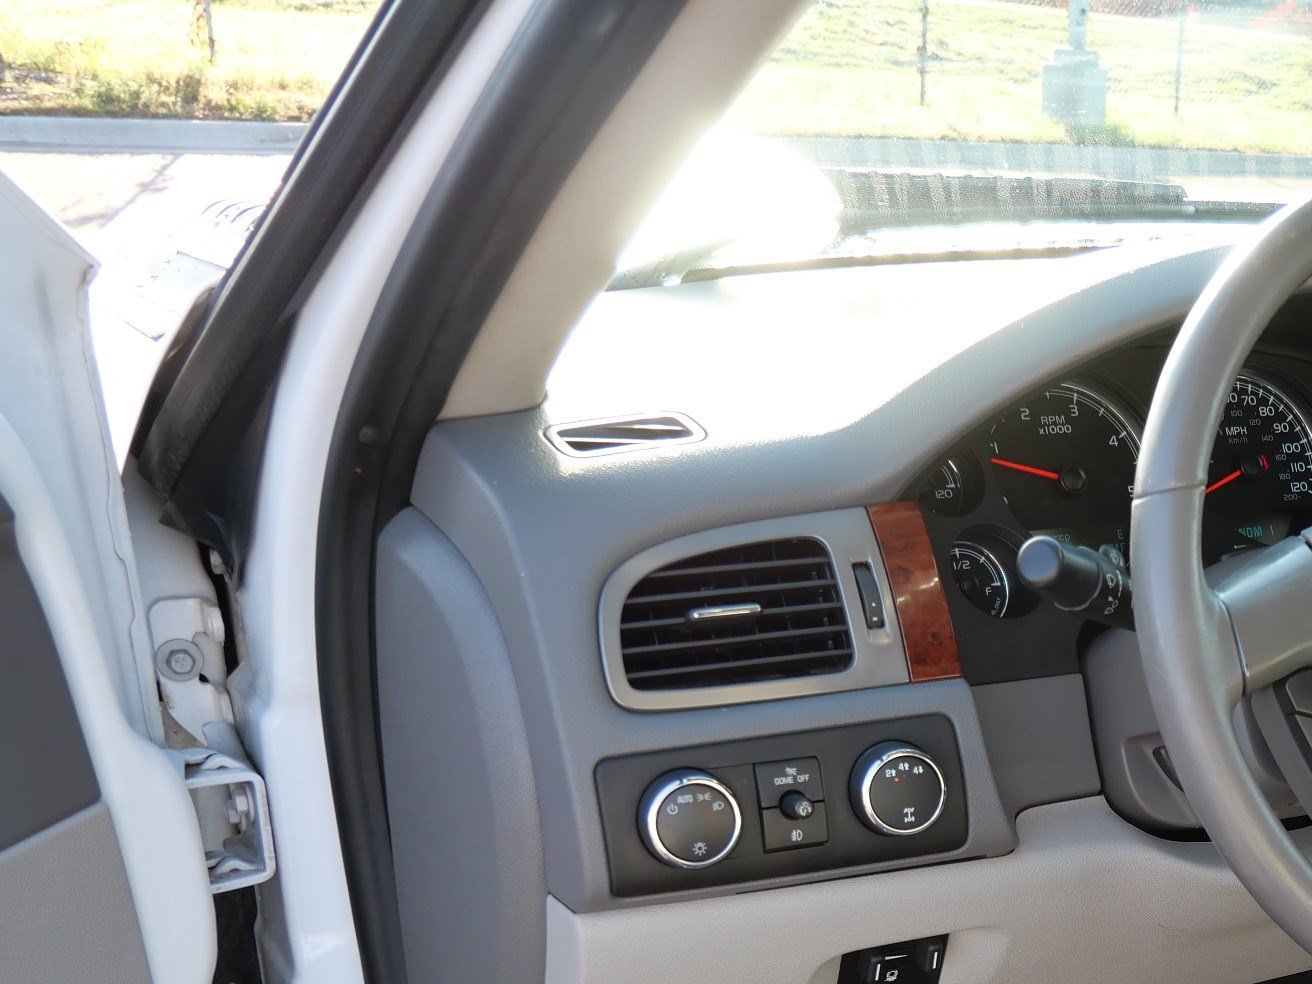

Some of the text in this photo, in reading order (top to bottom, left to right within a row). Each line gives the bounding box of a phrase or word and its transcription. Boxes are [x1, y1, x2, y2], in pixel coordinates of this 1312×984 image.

[1241, 394, 1257, 406] 70
[1019, 407, 1031, 421] 2
[1068, 404, 1079, 417] 3
[1258, 406, 1275, 417] 80
[1040, 415, 1066, 425] RPM
[1038, 424, 1072, 435] x1000
[1225, 426, 1248, 436] MPH
[1273, 422, 1290, 434] 90
[1108, 435, 1119, 447] 4
[1281, 442, 1301, 454] 100
[1290, 462, 1306, 472] 110
[1290, 482, 1308, 493] 120
[934, 489, 954, 500] 120
[952, 559, 971, 571] 1/2
[985, 586, 993, 597] F
[774, 774, 810, 786] DOME OFF
[677, 794, 694, 804] AUTO
